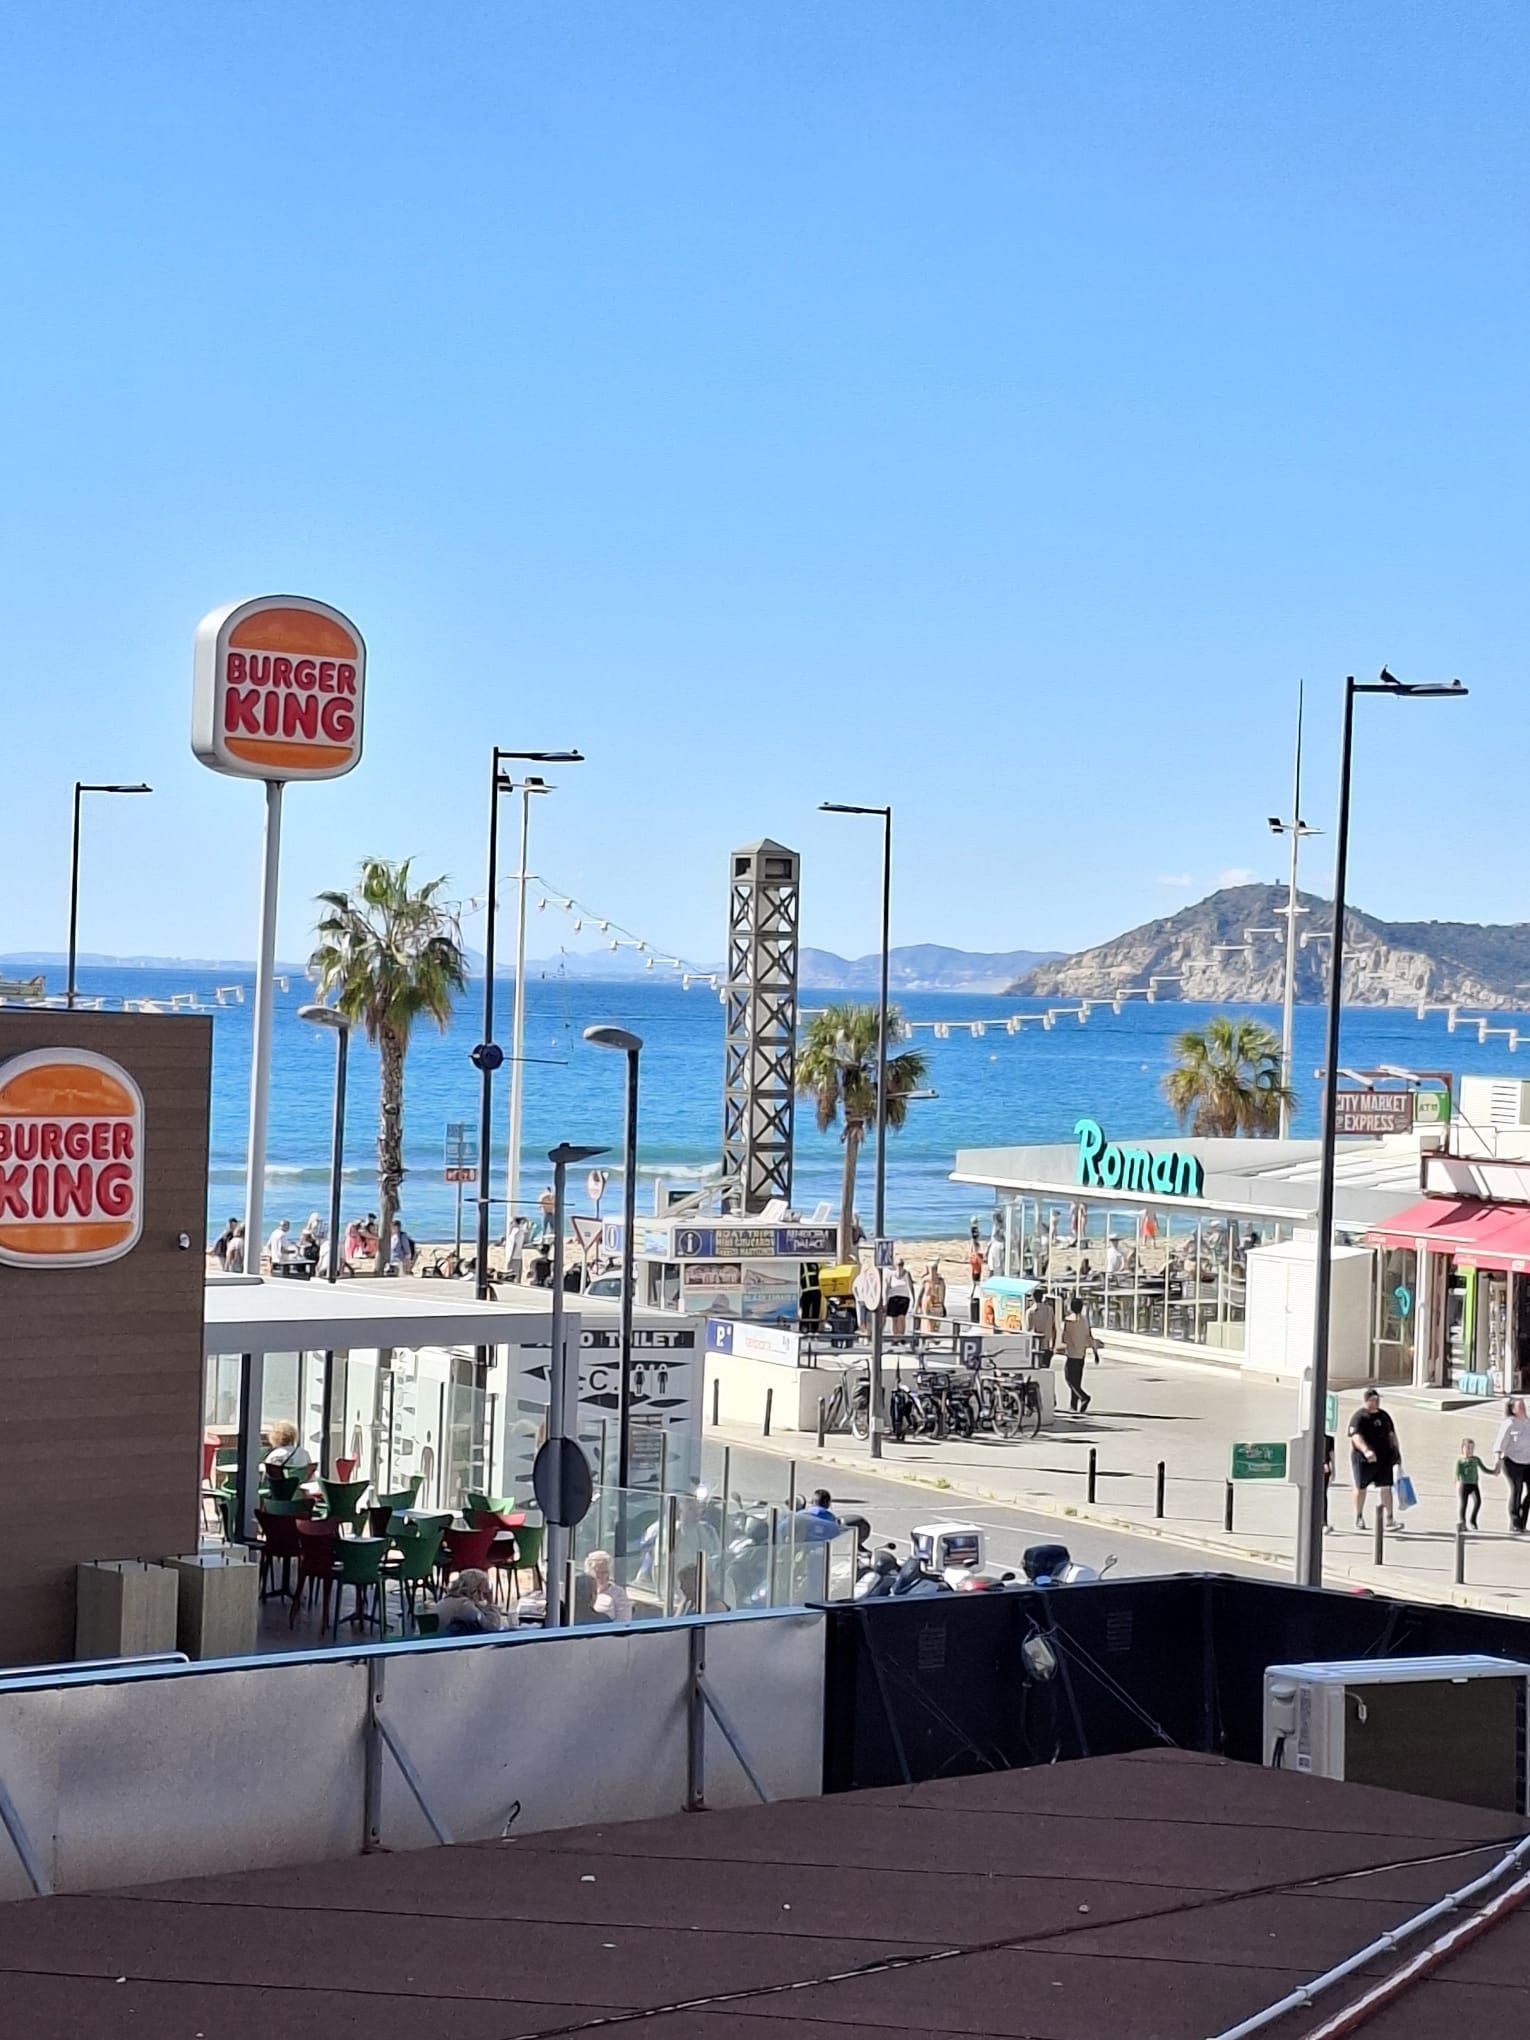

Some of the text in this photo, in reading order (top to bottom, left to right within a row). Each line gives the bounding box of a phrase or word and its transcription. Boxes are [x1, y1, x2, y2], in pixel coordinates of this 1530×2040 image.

[227, 652, 357, 695] BURGER
[225, 687, 355, 742] KING
[1344, 1114, 1395, 1131] EXPRESS
[1360, 1094, 1407, 1113] MARKET
[1074, 1119, 1200, 1197] Roman
[0, 1163, 134, 1219] KING
[605, 1332, 679, 1347] TILET
